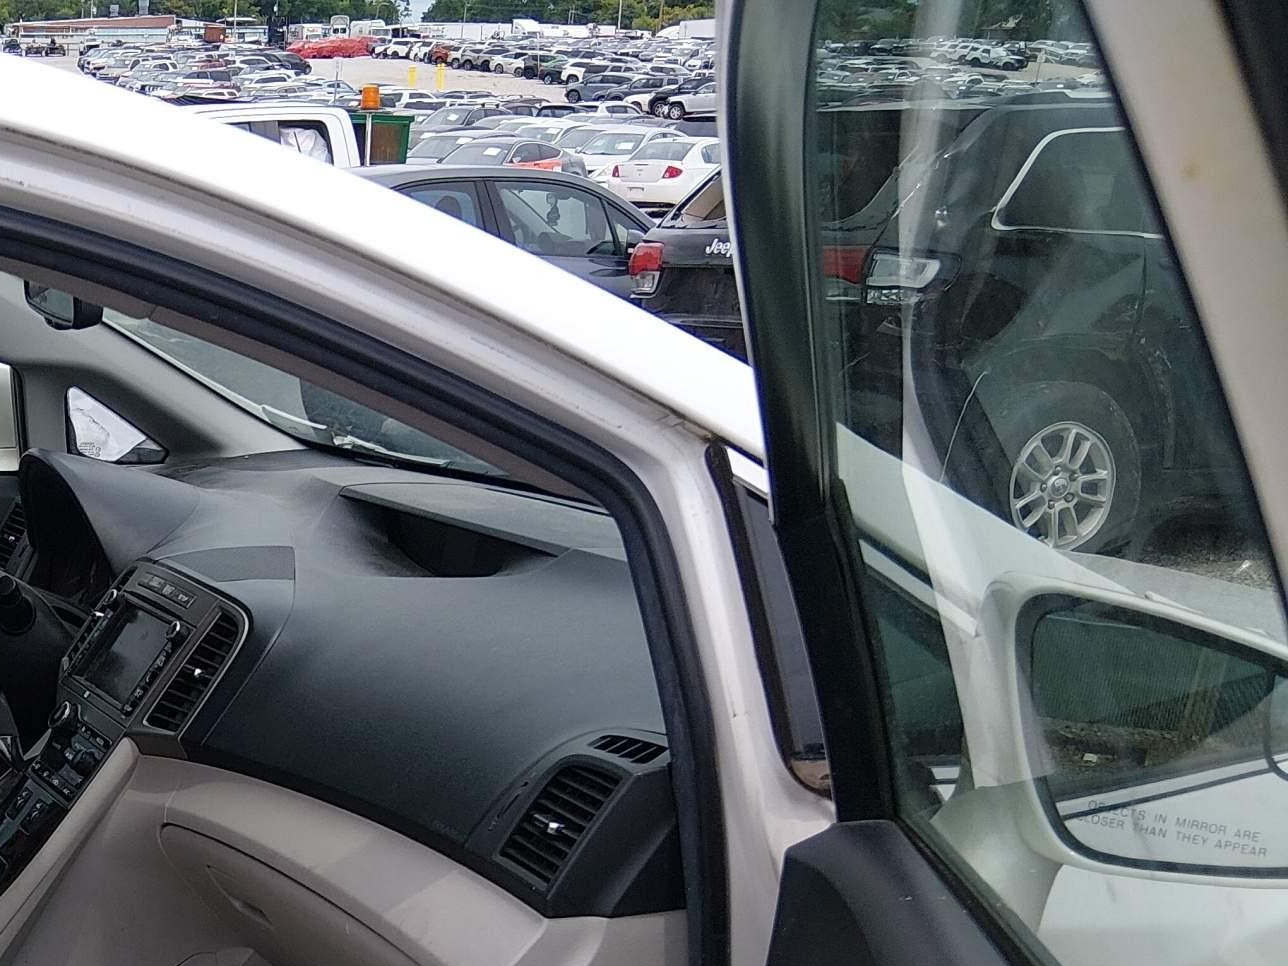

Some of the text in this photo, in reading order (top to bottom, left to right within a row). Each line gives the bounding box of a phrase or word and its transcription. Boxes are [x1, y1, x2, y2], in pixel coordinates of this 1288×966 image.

[1087, 799, 1261, 843] OCTS IN MIRROR ARE
[1133, 821, 1168, 839] THAN
[1175, 830, 1210, 846] THEY
[1213, 839, 1268, 857] APPEAR
